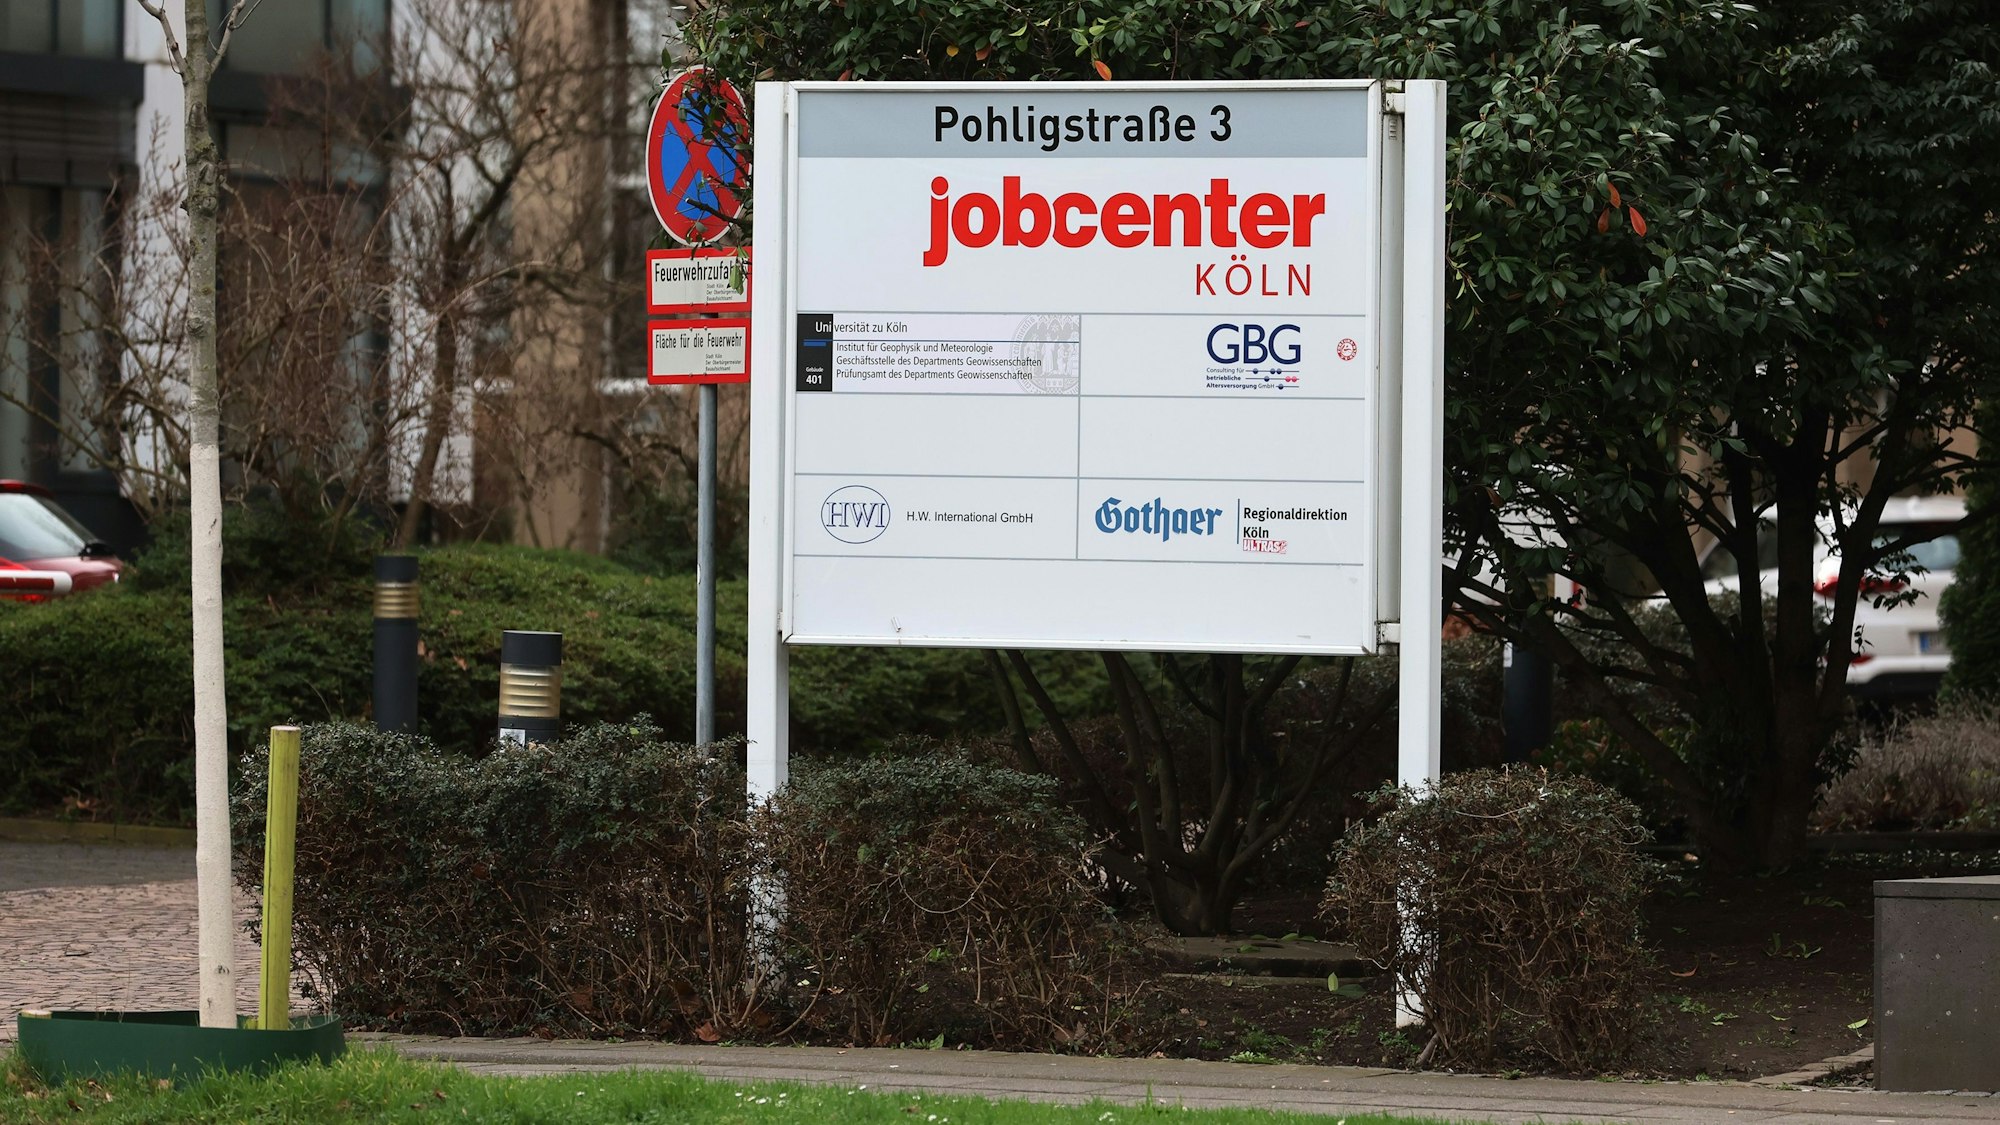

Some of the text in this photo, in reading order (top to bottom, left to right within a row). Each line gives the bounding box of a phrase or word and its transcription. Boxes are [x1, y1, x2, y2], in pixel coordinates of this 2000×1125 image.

[934, 104, 1232, 152] Pohligstraße 3
[923, 176, 1326, 267] jobcenter
[1195, 254, 1311, 296] KÖLN
[872, 324, 883, 333] zu
[886, 322, 908, 333] Köln
[655, 332, 742, 349] Fläche für die Feuerwehr
[1206, 323, 1301, 365] GBG
[836, 343, 993, 354] Institut für Geophysik und Meteorologie
[836, 356, 1042, 367] Geschäftsstelle des Departments Geowissenschaften
[805, 375, 823, 384] 401
[836, 369, 1033, 380] Prüfungsamt des Departments Geowissenschaften
[826, 502, 886, 528] HWI
[906, 511, 1034, 524] H.W. International GmbH
[1095, 496, 1223, 542] Gothaer
[1243, 507, 1348, 522] Regionaldirektion
[1243, 526, 1269, 538] Köln
